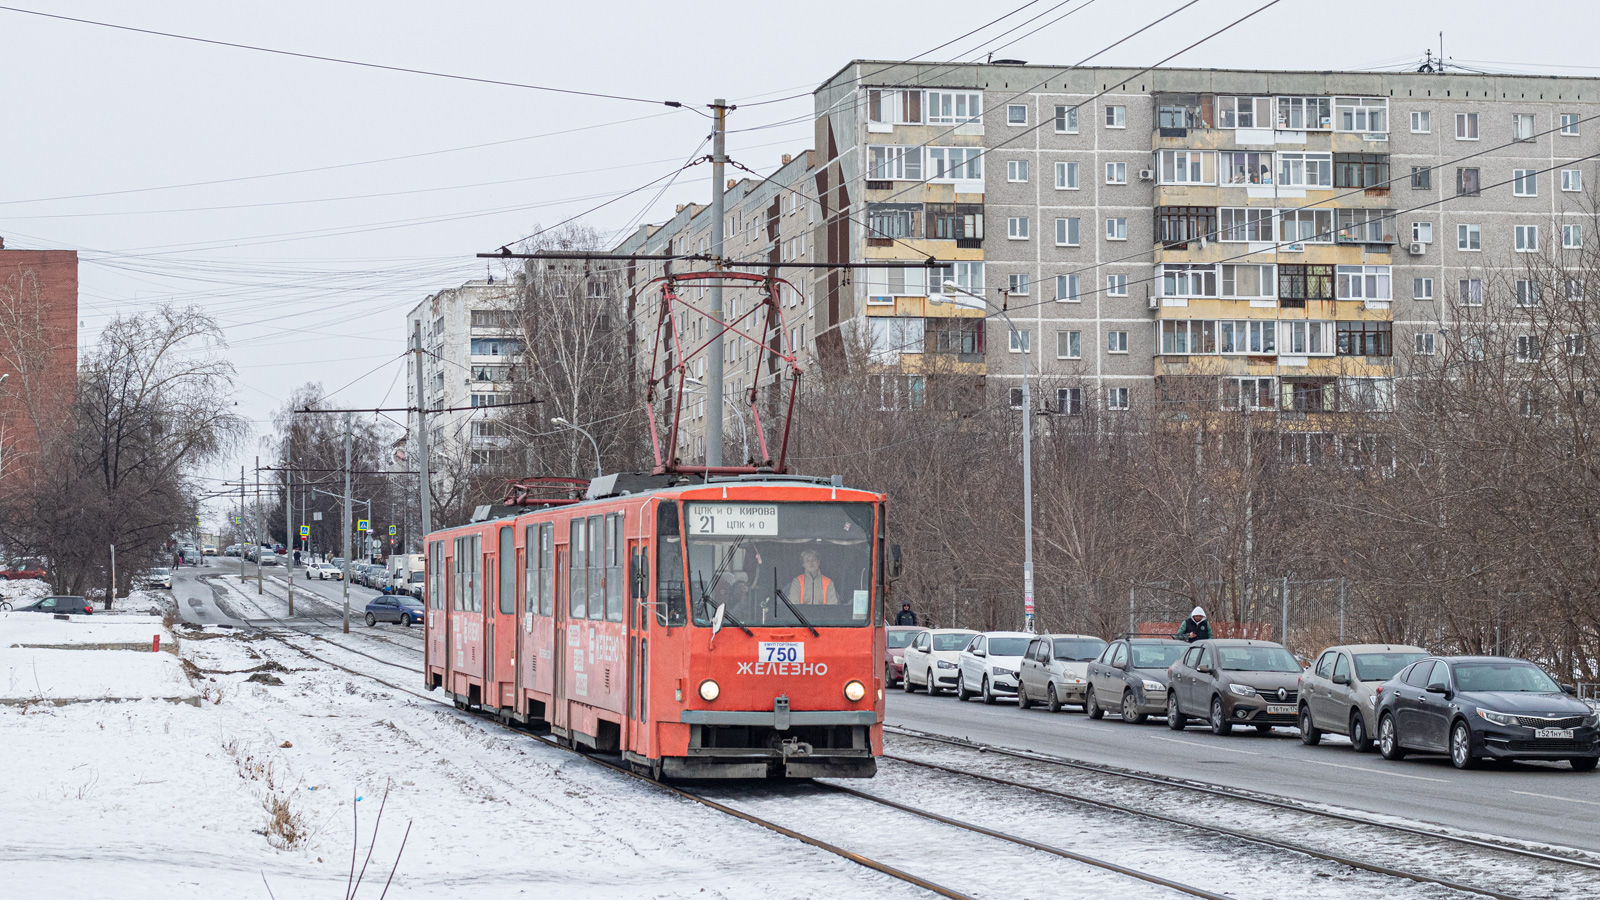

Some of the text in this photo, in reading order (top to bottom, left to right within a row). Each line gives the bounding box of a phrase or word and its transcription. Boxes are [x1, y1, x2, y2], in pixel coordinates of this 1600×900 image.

[694, 507, 712, 516] ЦПК
[700, 516, 714, 533] 21
[726, 521, 744, 530] ЦПК
[766, 647, 797, 662] 750
[736, 662, 828, 676] ЖЕЛЕЗНО
